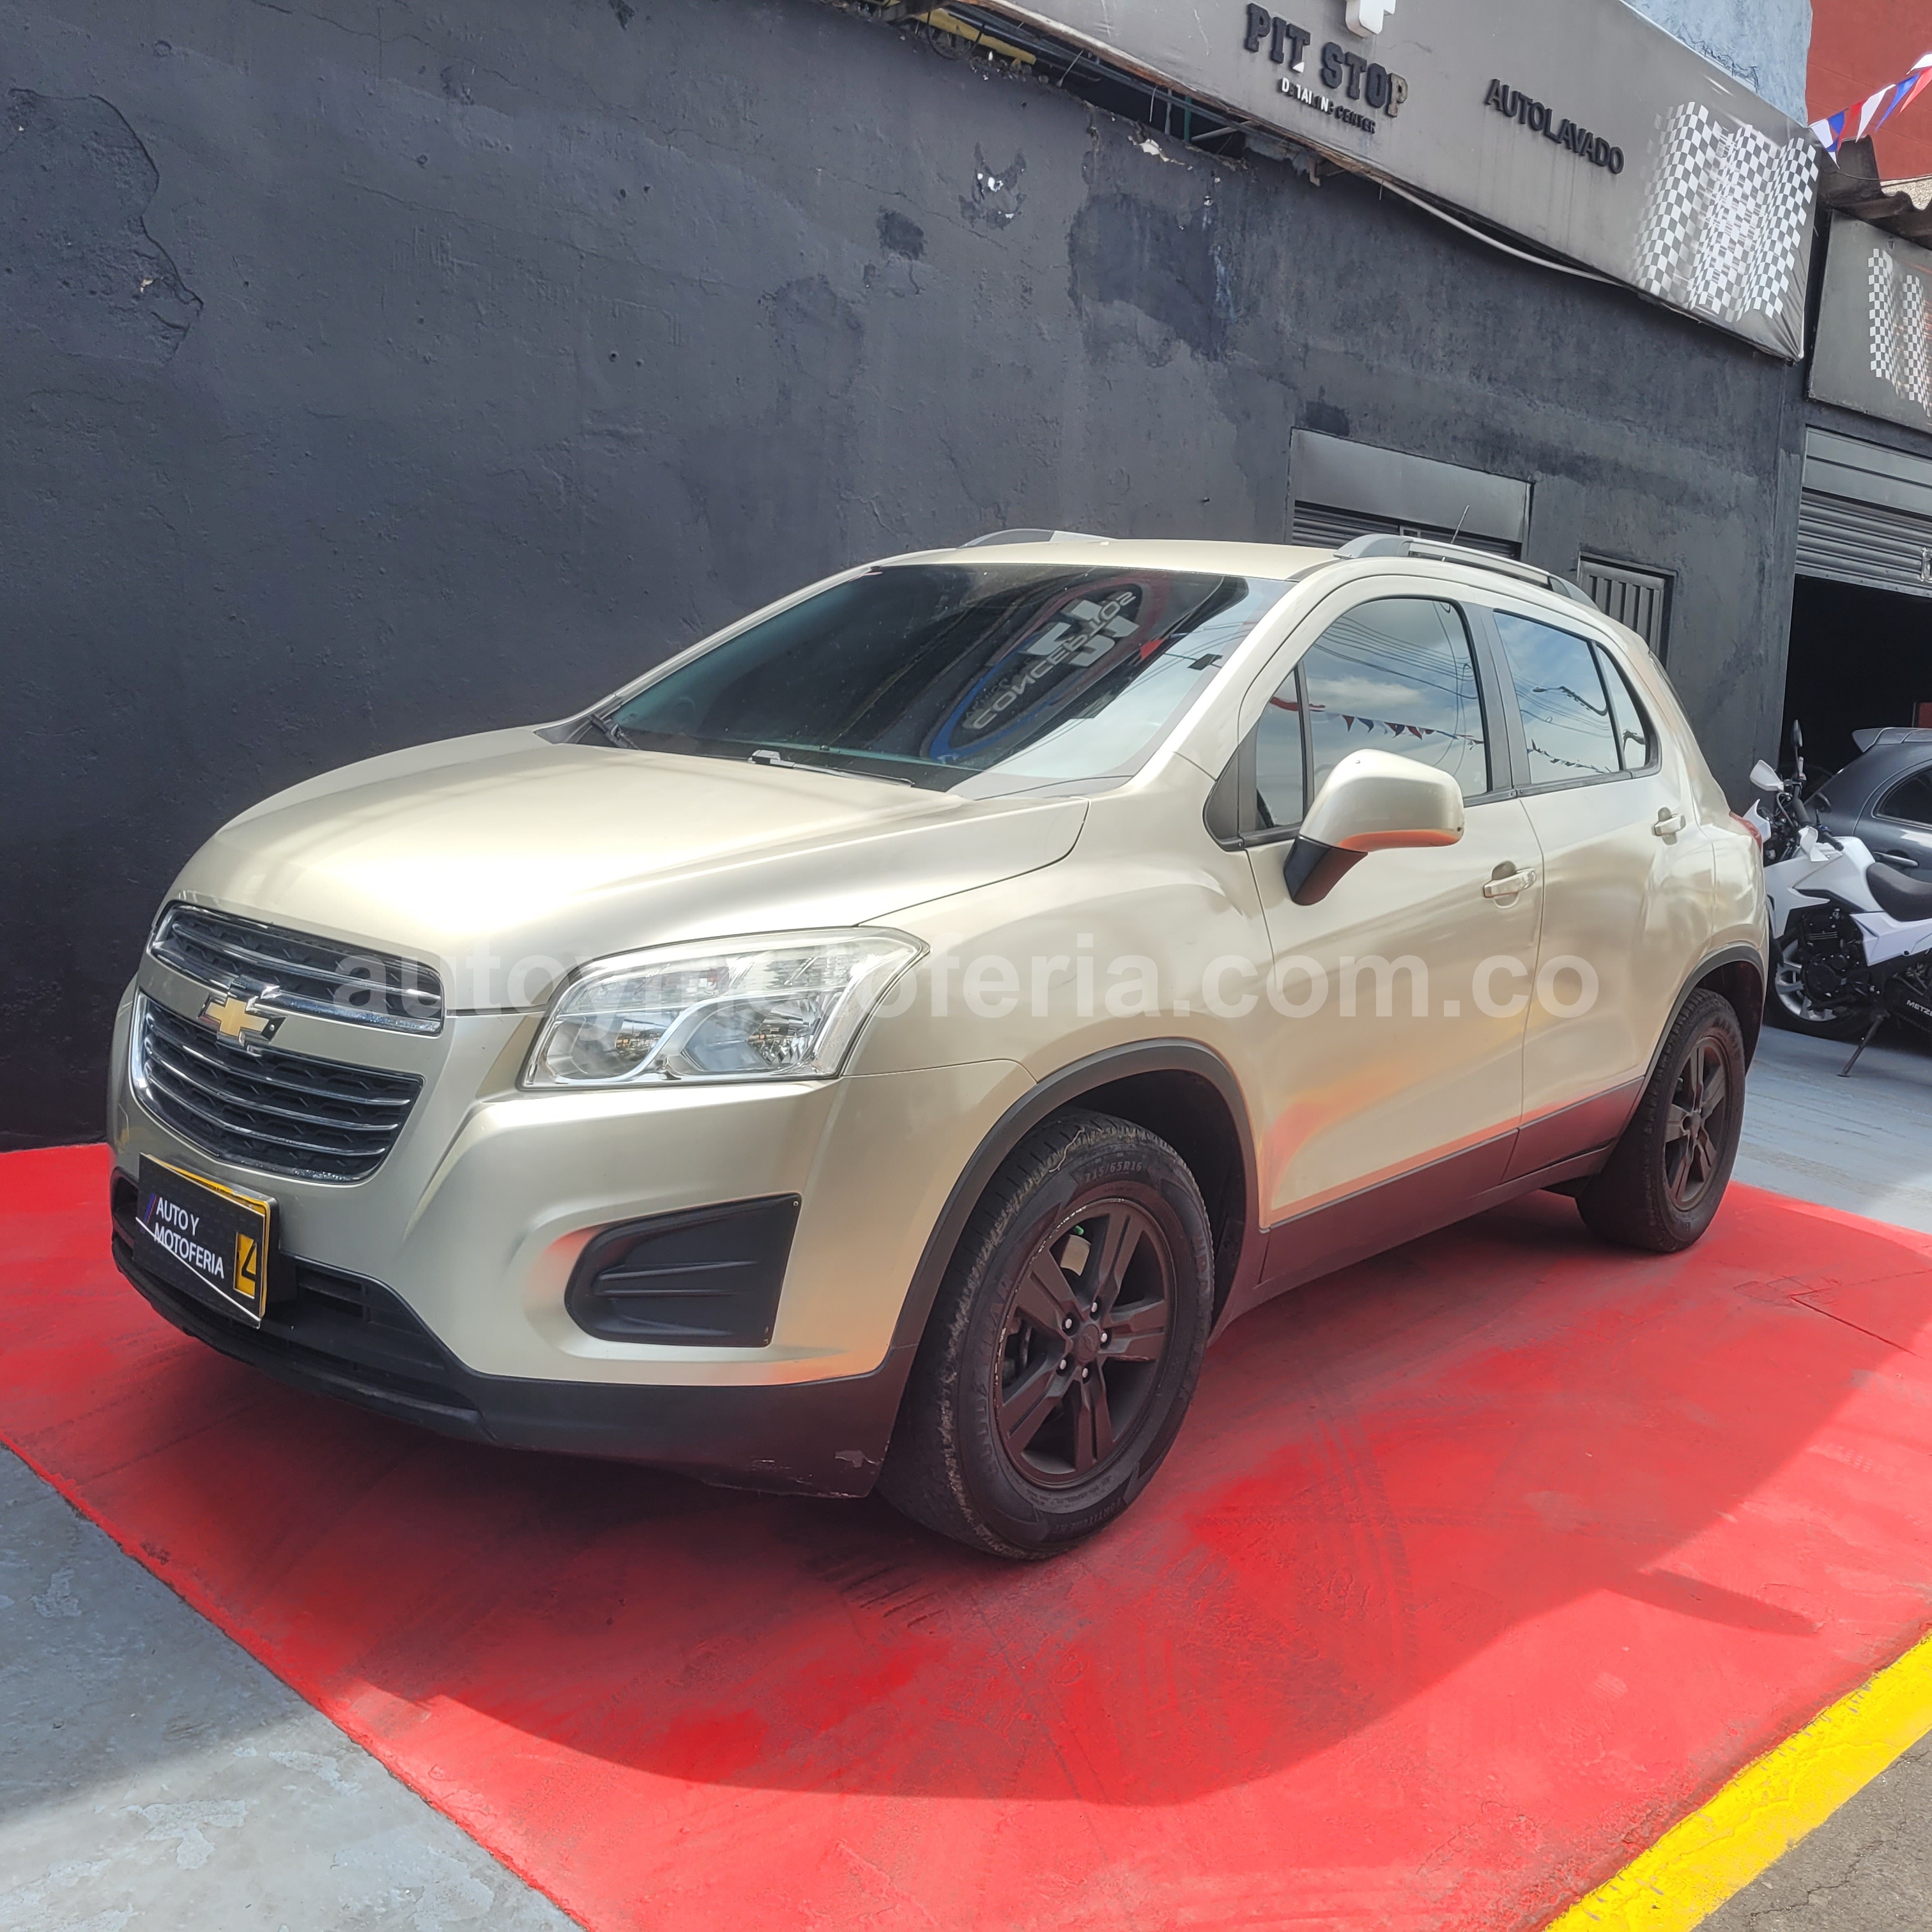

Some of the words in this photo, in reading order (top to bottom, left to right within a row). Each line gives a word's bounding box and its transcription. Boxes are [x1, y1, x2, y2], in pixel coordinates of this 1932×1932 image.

[1244, 2, 1311, 68] PIT
[1321, 41, 1407, 118] STOP
[1335, 105, 1376, 134] CENTER
[1484, 78, 1625, 174] AUTOLAVADO
[156, 1197, 188, 1230] AUTO
[190, 1214, 199, 1236] Y
[153, 1222, 224, 1279] MOTOFERIA
